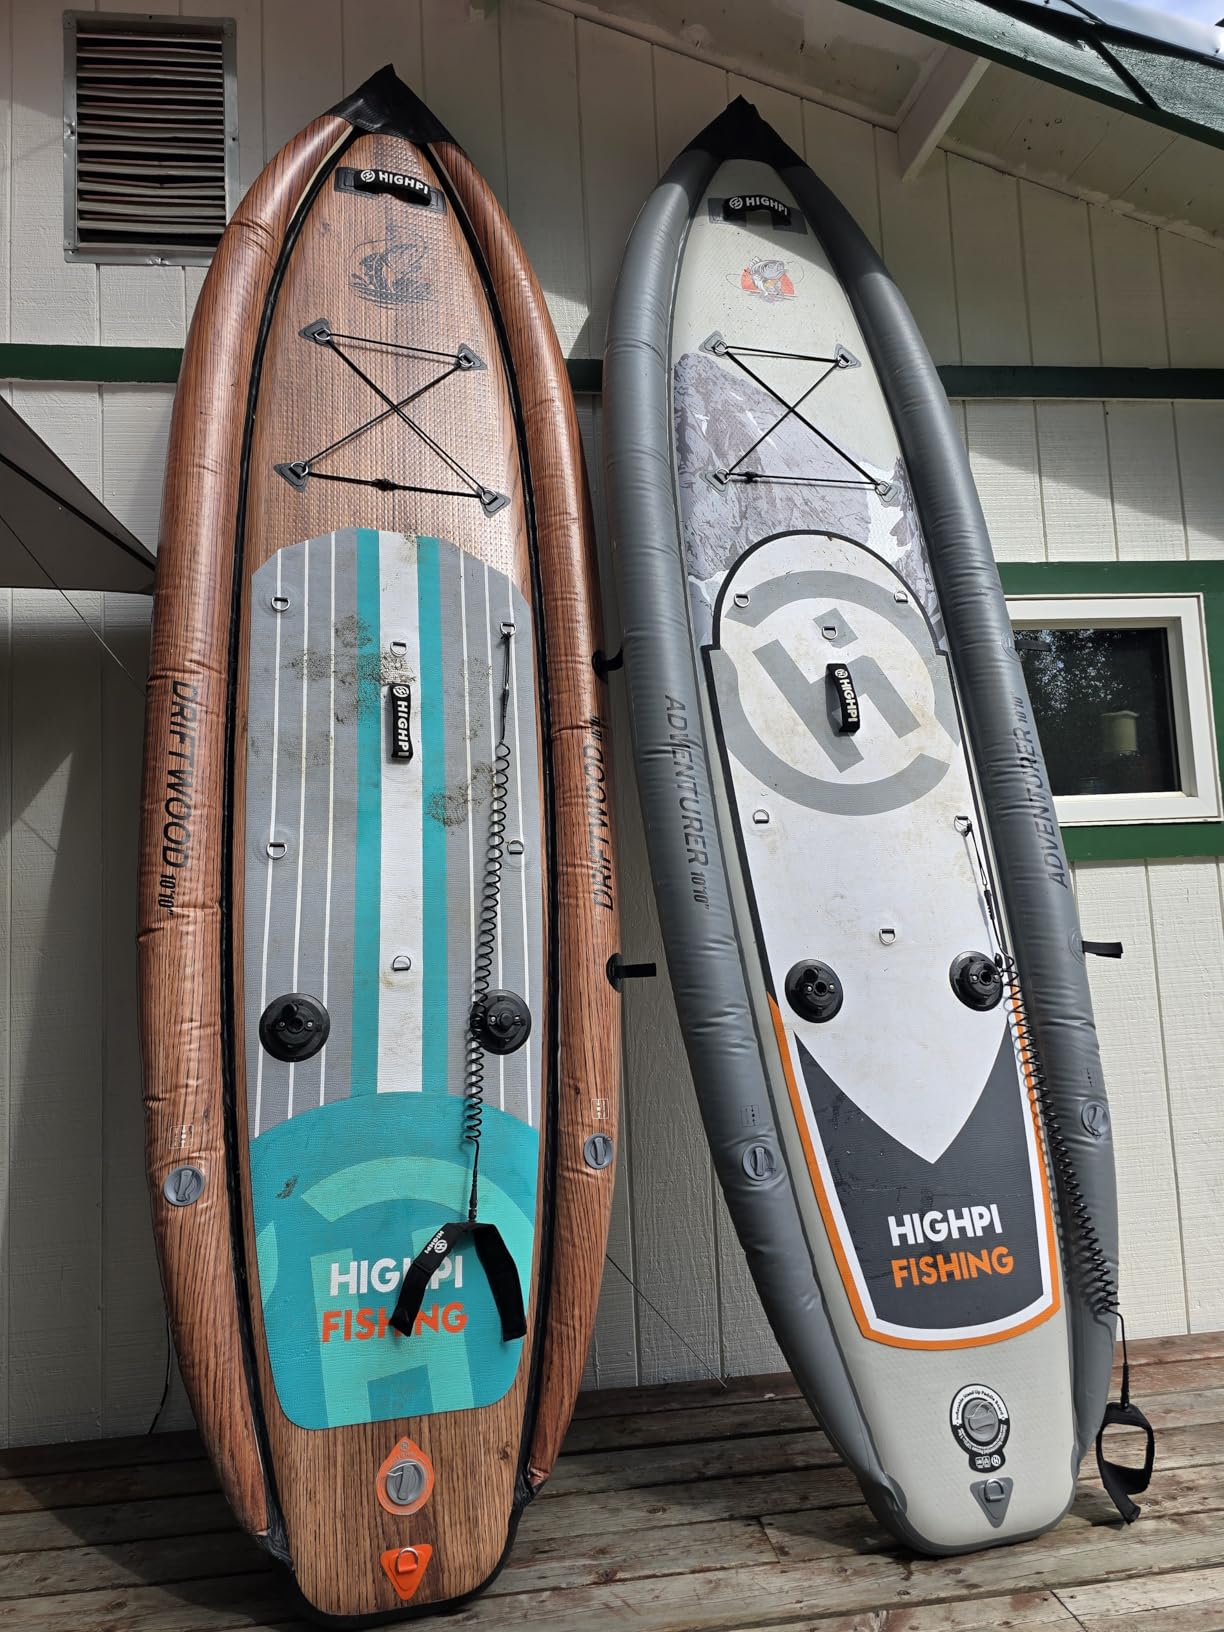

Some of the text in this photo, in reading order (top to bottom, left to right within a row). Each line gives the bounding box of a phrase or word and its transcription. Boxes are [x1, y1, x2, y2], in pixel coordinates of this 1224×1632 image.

[378, 171, 429, 195] HIGHPI
[745, 196, 788, 216] HIGHPI
[839, 678, 858, 722] HIGHPI
[397, 700, 409, 757] HIGHPI
[162, 680, 200, 869] DRIFTWOOD
[664, 694, 710, 867] ADVENTURER
[583, 744, 614, 911] DRIFTWOOD
[1012, 728, 1068, 889] ADVENTURER
[424, 1230, 445, 1254] HIGHPI
[887, 1203, 1003, 1247] HIGHPI
[890, 1245, 1015, 1289] FISHING
